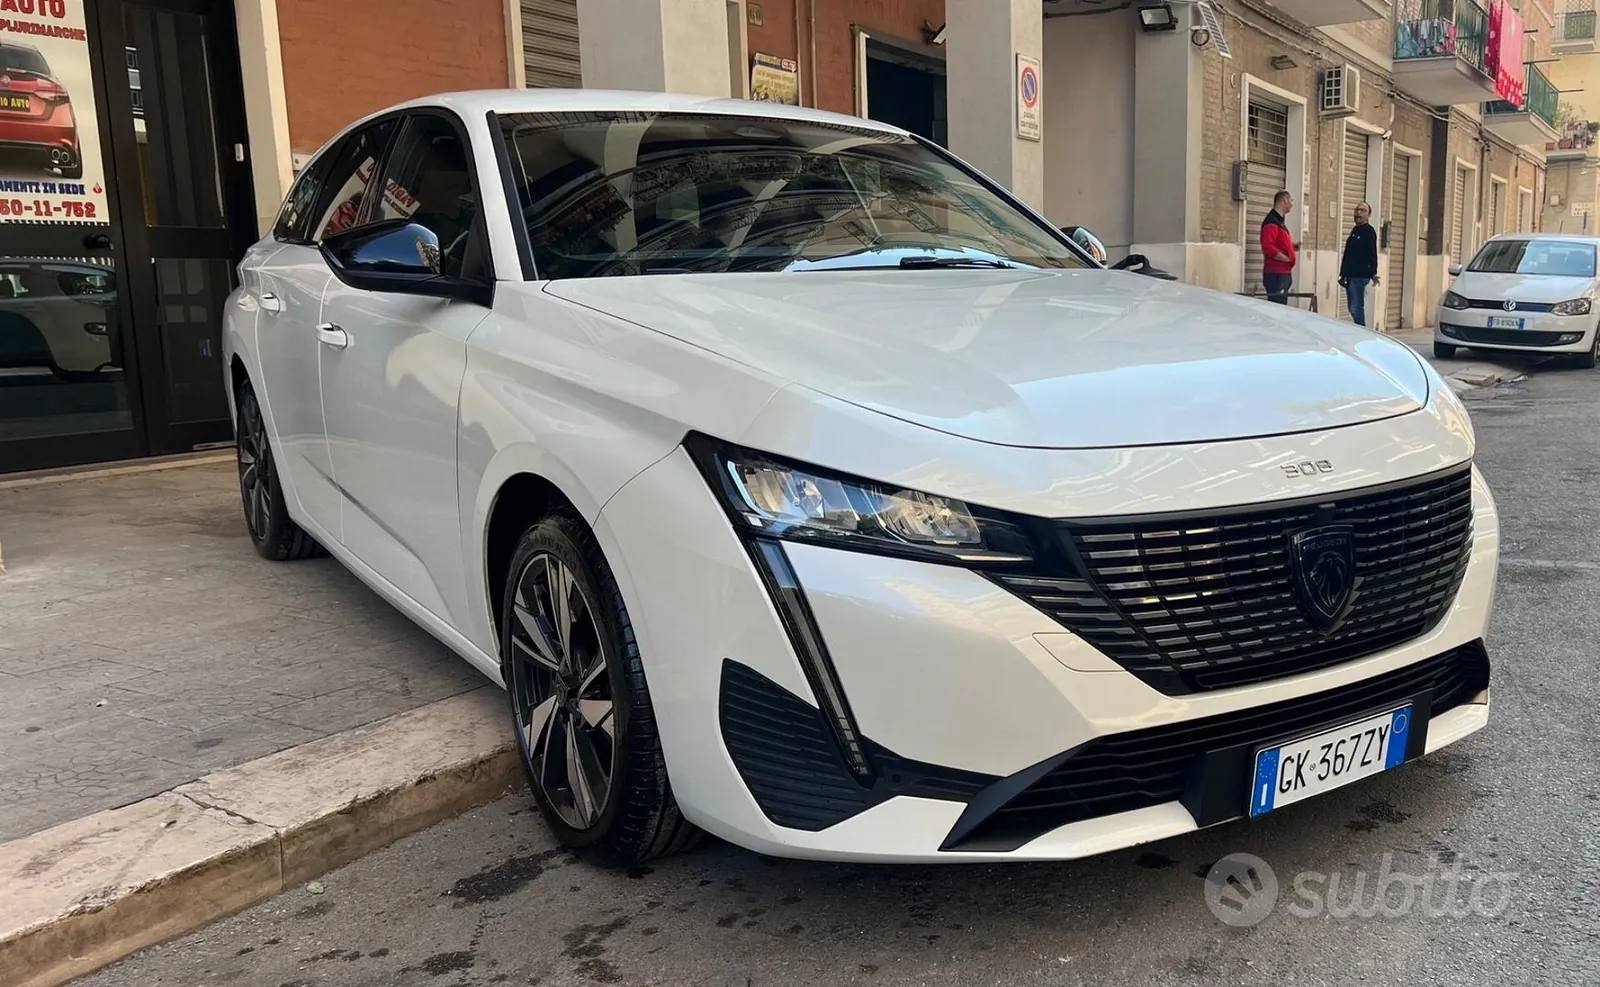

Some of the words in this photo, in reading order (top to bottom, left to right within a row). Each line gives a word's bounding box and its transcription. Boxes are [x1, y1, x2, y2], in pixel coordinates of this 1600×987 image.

[1, 0, 66, 19] AUTO
[0, 18, 86, 41] PLURIMARCHE
[10, 97, 30, 109] AUTO
[58, 183, 86, 196] SEDE
[1280, 459, 1333, 479] 308
[1303, 537, 1348, 551] PEUGEOT
